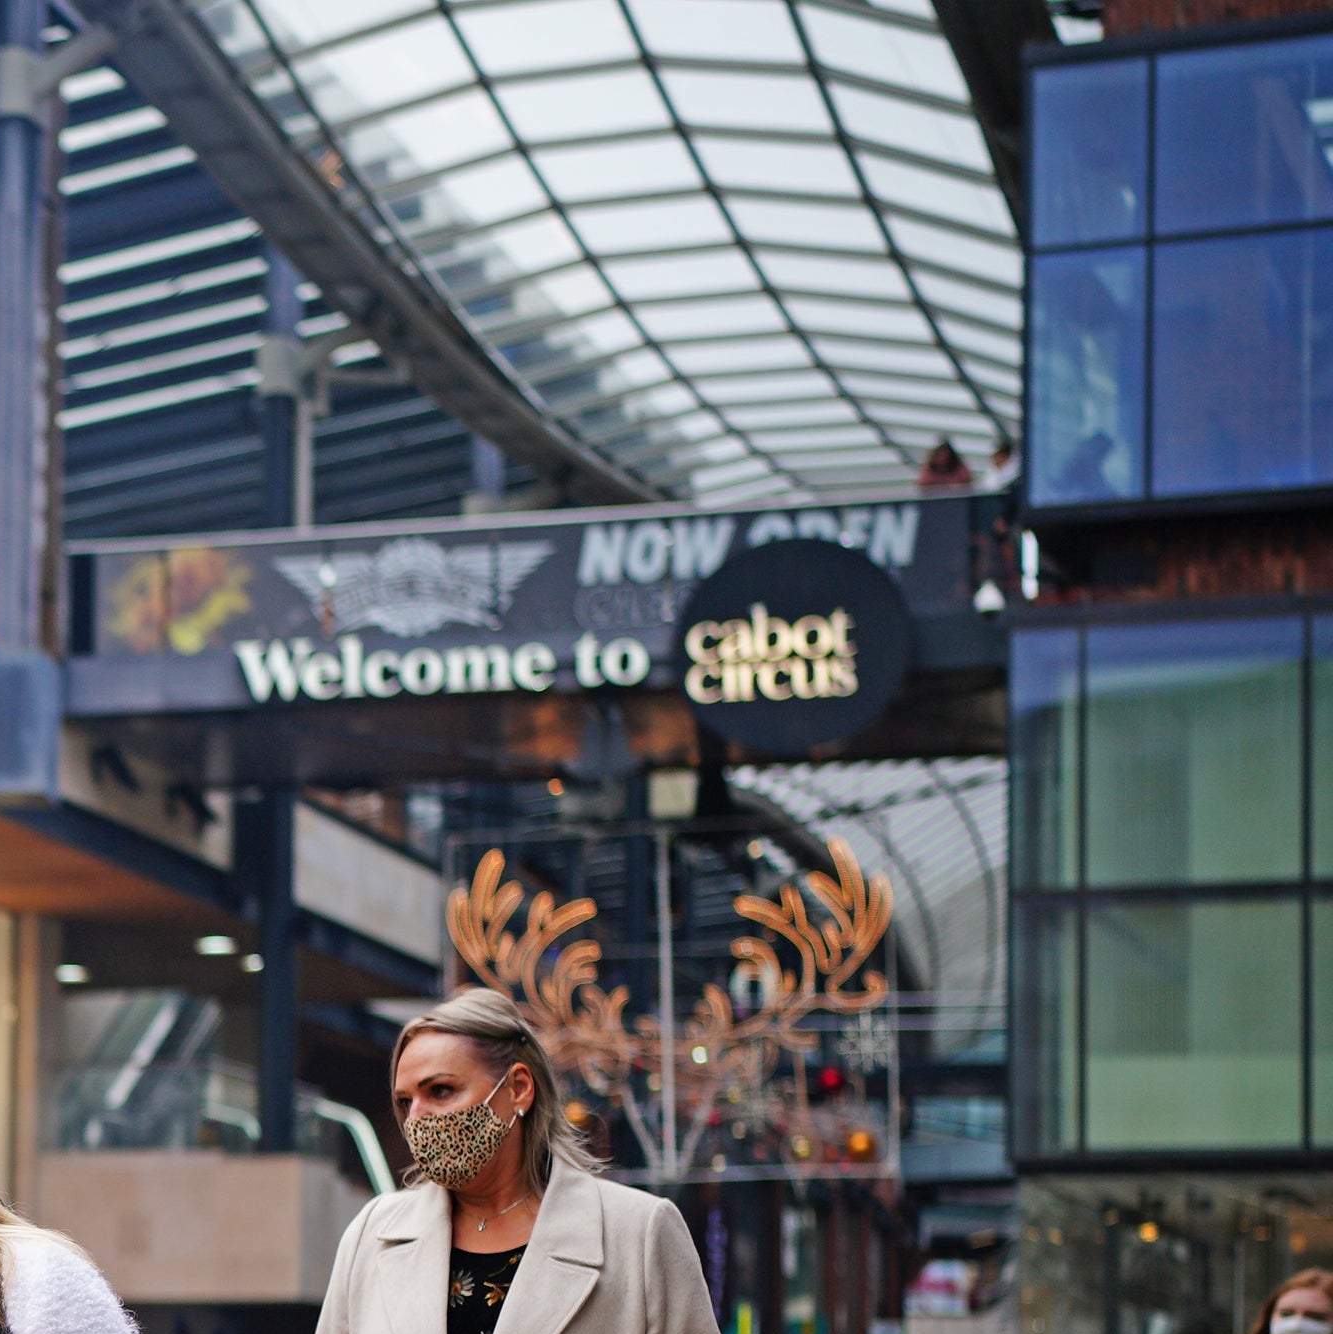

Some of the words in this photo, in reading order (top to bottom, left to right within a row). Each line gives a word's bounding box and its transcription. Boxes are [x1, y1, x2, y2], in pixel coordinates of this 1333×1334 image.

[577, 516, 733, 586] NOW
[234, 633, 557, 702] Welcome
[573, 631, 650, 688] to
[684, 602, 858, 666] cabot
[684, 656, 859, 705] circus
